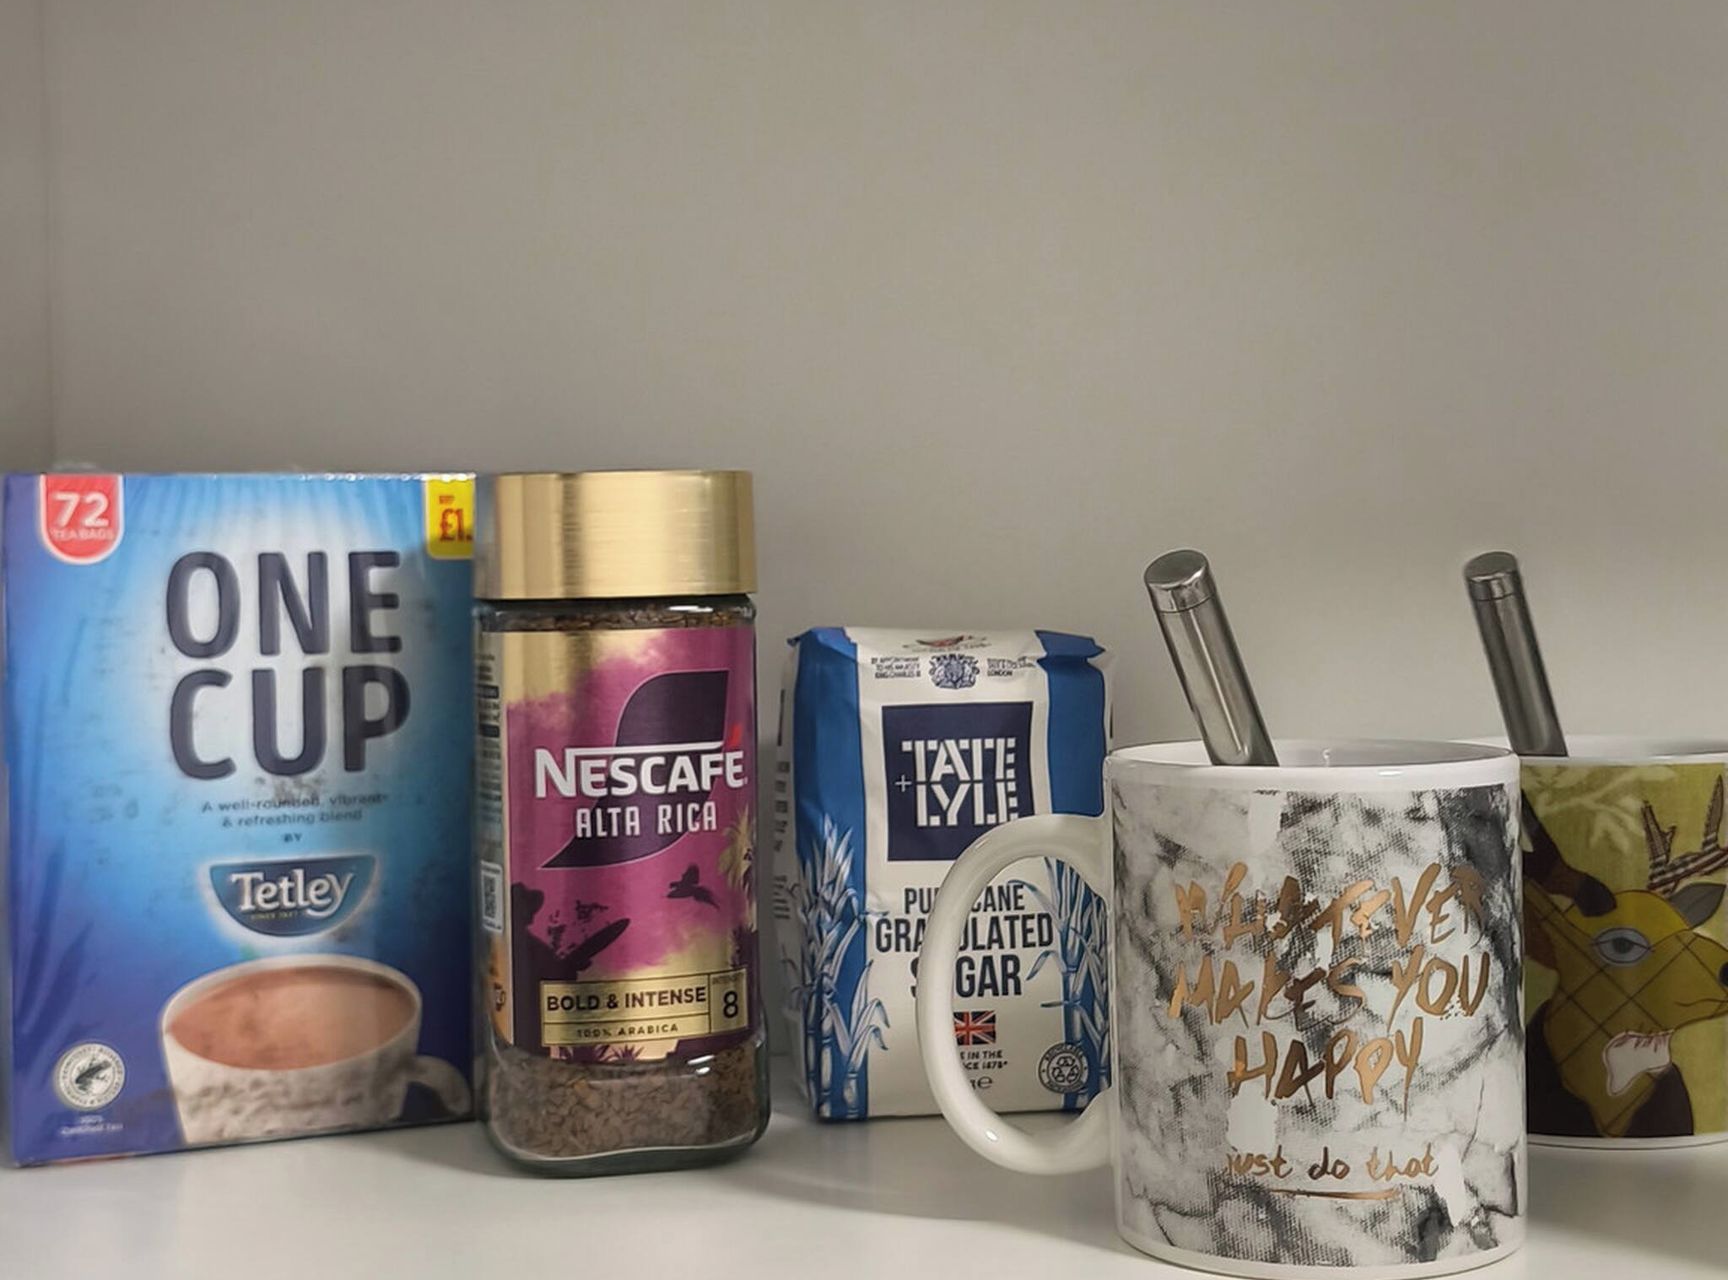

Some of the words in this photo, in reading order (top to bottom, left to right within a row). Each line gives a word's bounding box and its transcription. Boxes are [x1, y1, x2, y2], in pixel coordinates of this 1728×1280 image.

[54, 492, 109, 529] 72
[166, 551, 403, 660] ONE
[170, 665, 411, 780] CUP
[902, 737, 1017, 782] TATE
[202, 802, 213, 813] A
[239, 812, 316, 827] refreshing
[320, 810, 363, 822] blend
[576, 806, 641, 838] ALTA
[657, 801, 717, 835] RICA
[916, 780, 1019, 827] LYLE
[230, 869, 354, 917] Tetley
[547, 994, 600, 1012] BOLD
[606, 993, 619, 1010] &
[625, 986, 707, 1009] INTENSE
[723, 990, 739, 1019] 8
[1168, 950, 1367, 1032] MAKES
[1387, 944, 1491, 1034] YOU
[577, 1028, 613, 1039] 100%
[618, 1023, 679, 1036] ARABICA
[983, 1050, 1003, 1059] THE
[1226, 1016, 1424, 1122] HAPPY
[1226, 1145, 1293, 1179] just
[1307, 1146, 1351, 1181] do
[1366, 1142, 1440, 1181] that
